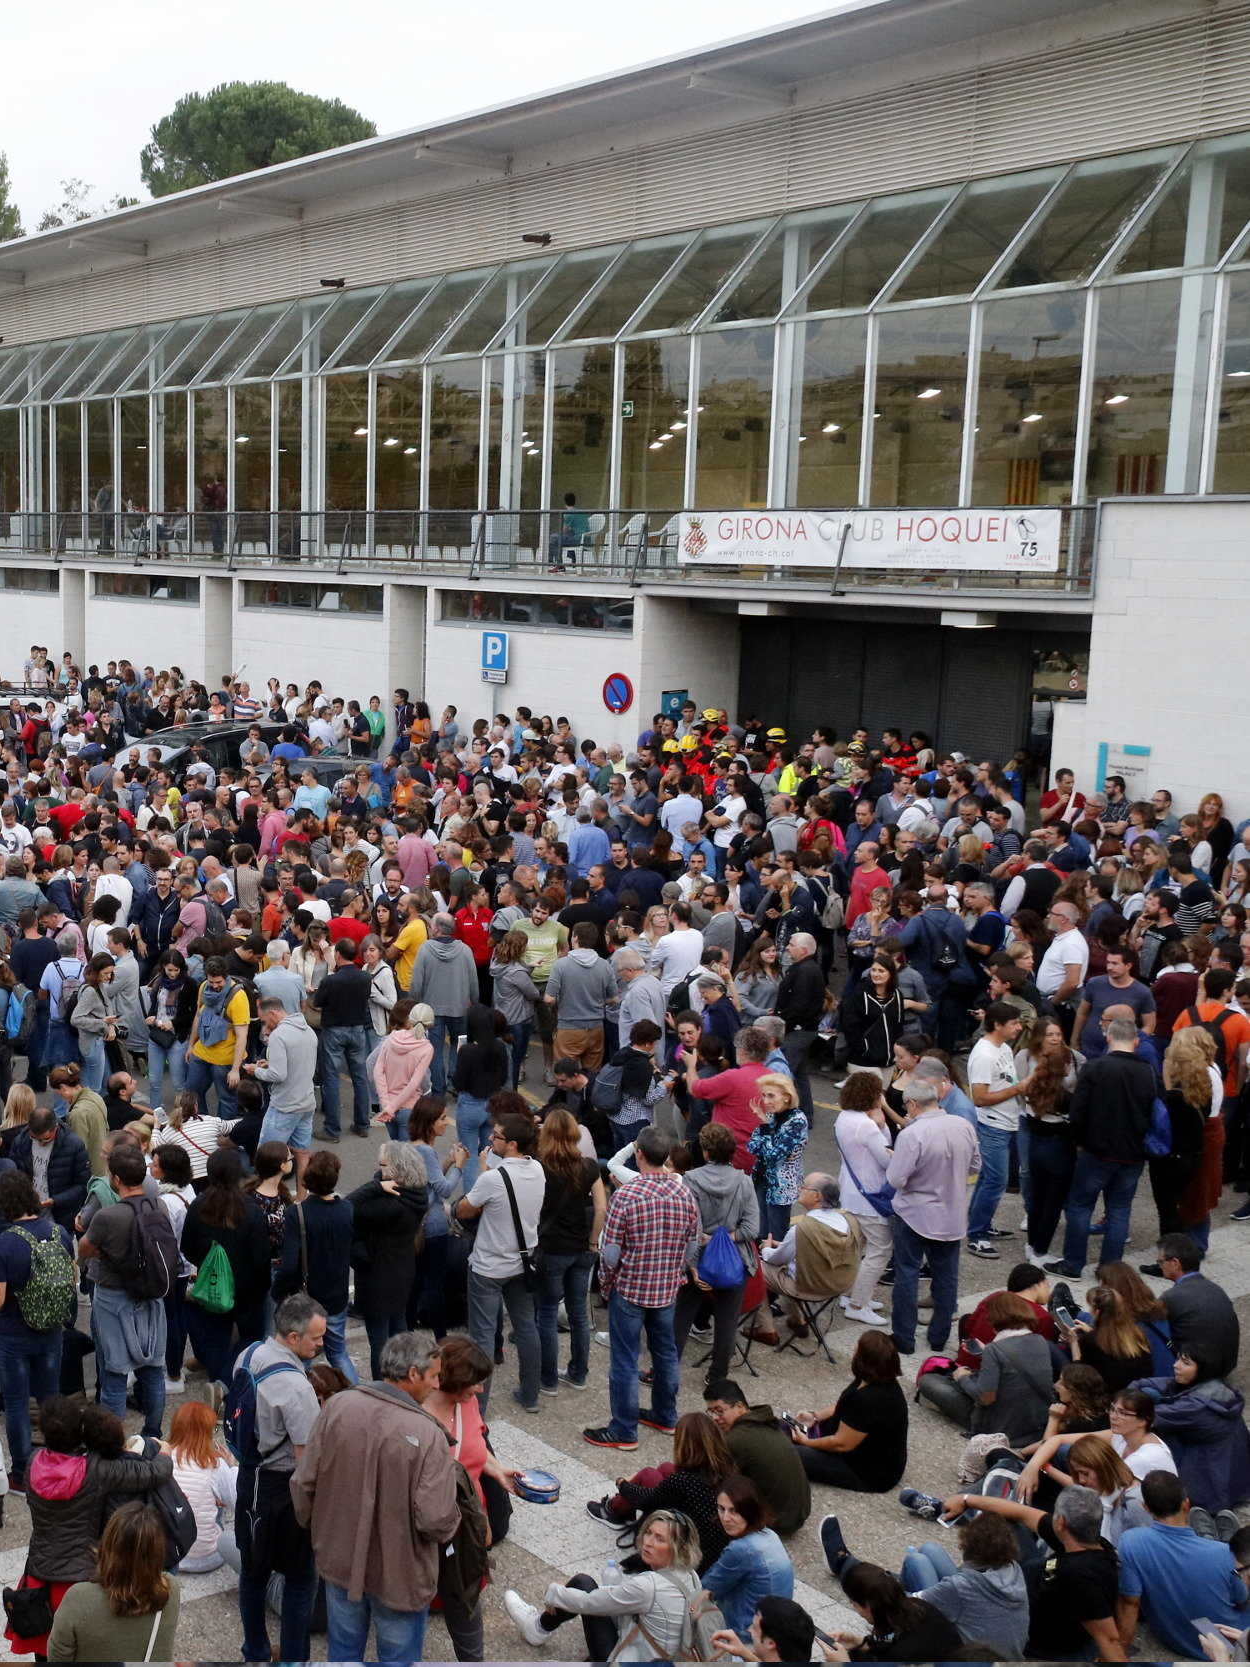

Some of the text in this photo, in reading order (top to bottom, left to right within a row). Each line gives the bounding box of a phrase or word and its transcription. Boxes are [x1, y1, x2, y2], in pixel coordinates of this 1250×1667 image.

[718, 517, 1008, 544] GIRONA CLUB HOQUEI
[1020, 542, 1038, 557] 75
[486, 636, 502, 664] P
